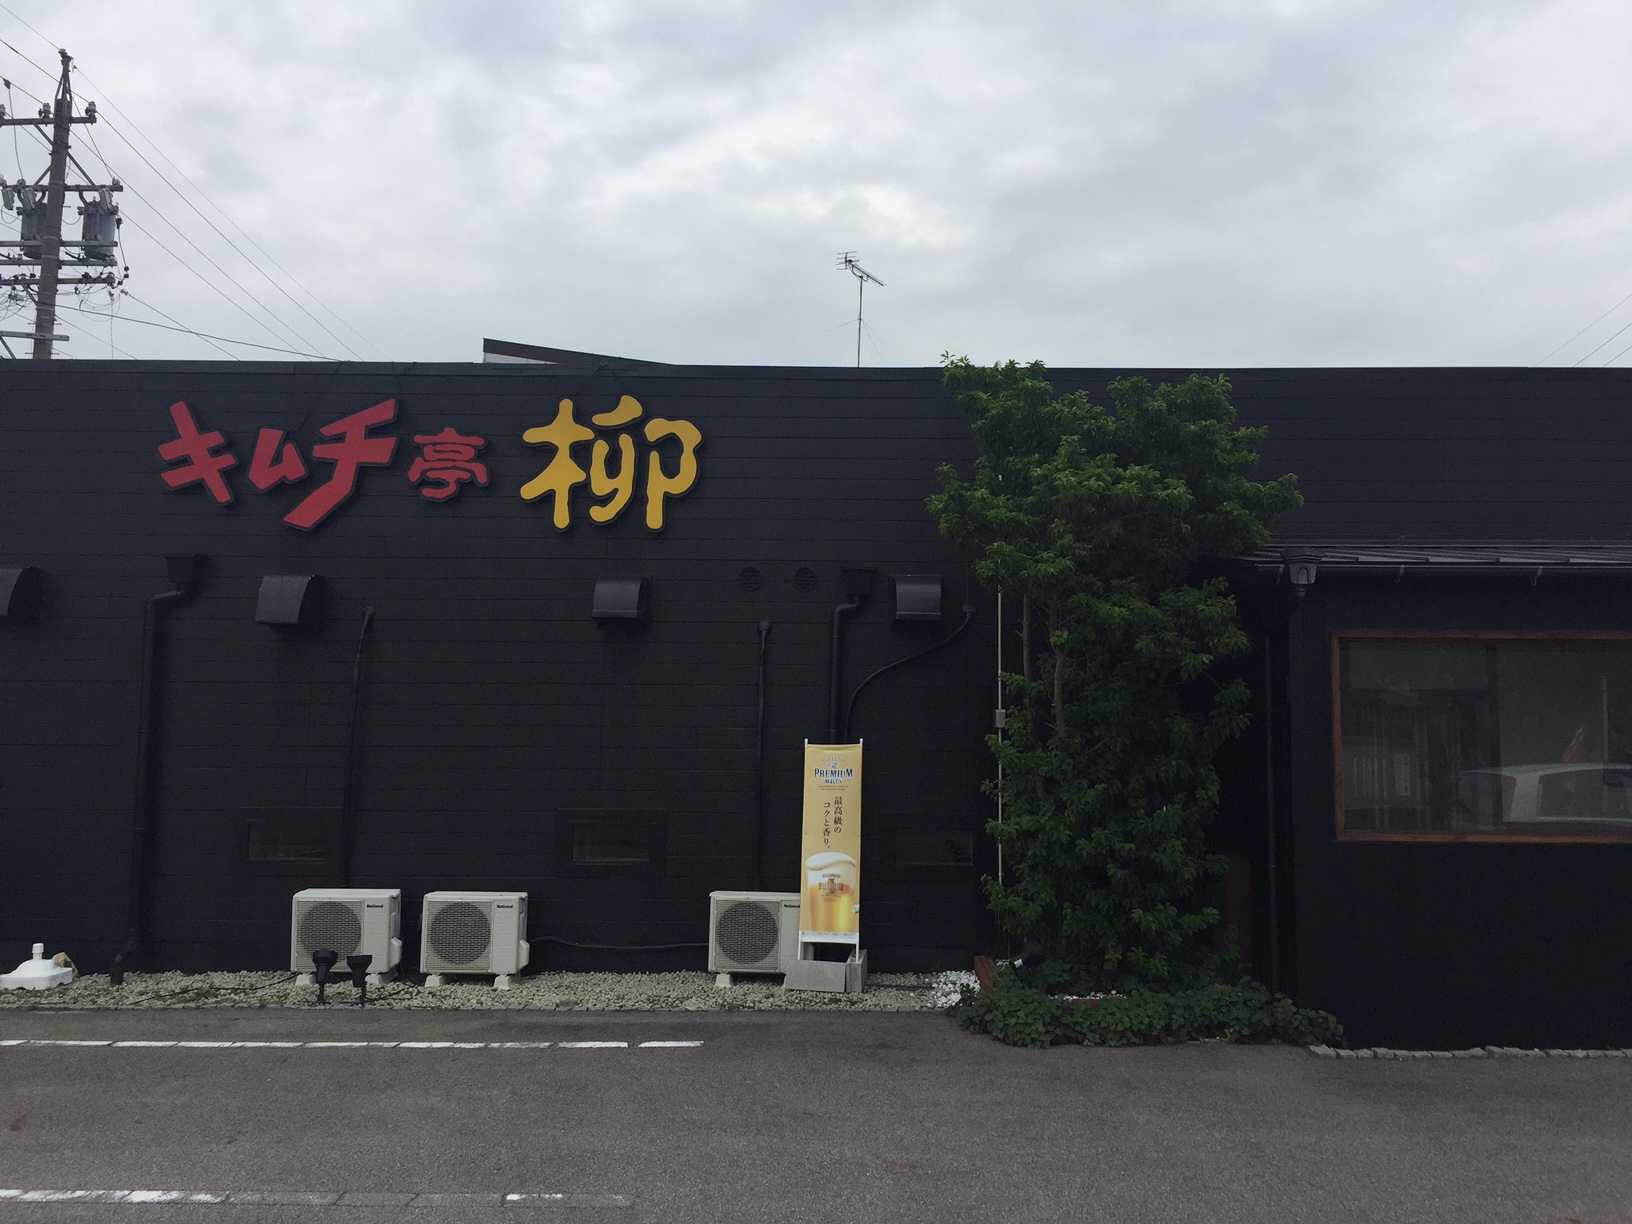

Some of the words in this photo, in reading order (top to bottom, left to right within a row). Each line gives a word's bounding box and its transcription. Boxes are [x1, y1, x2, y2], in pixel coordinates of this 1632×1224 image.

[156, 397, 489, 530] キムチ亭
[519, 394, 704, 530] 柳
[814, 768, 853, 778] PREMIUM
[834, 796, 843, 834] 最高級の
